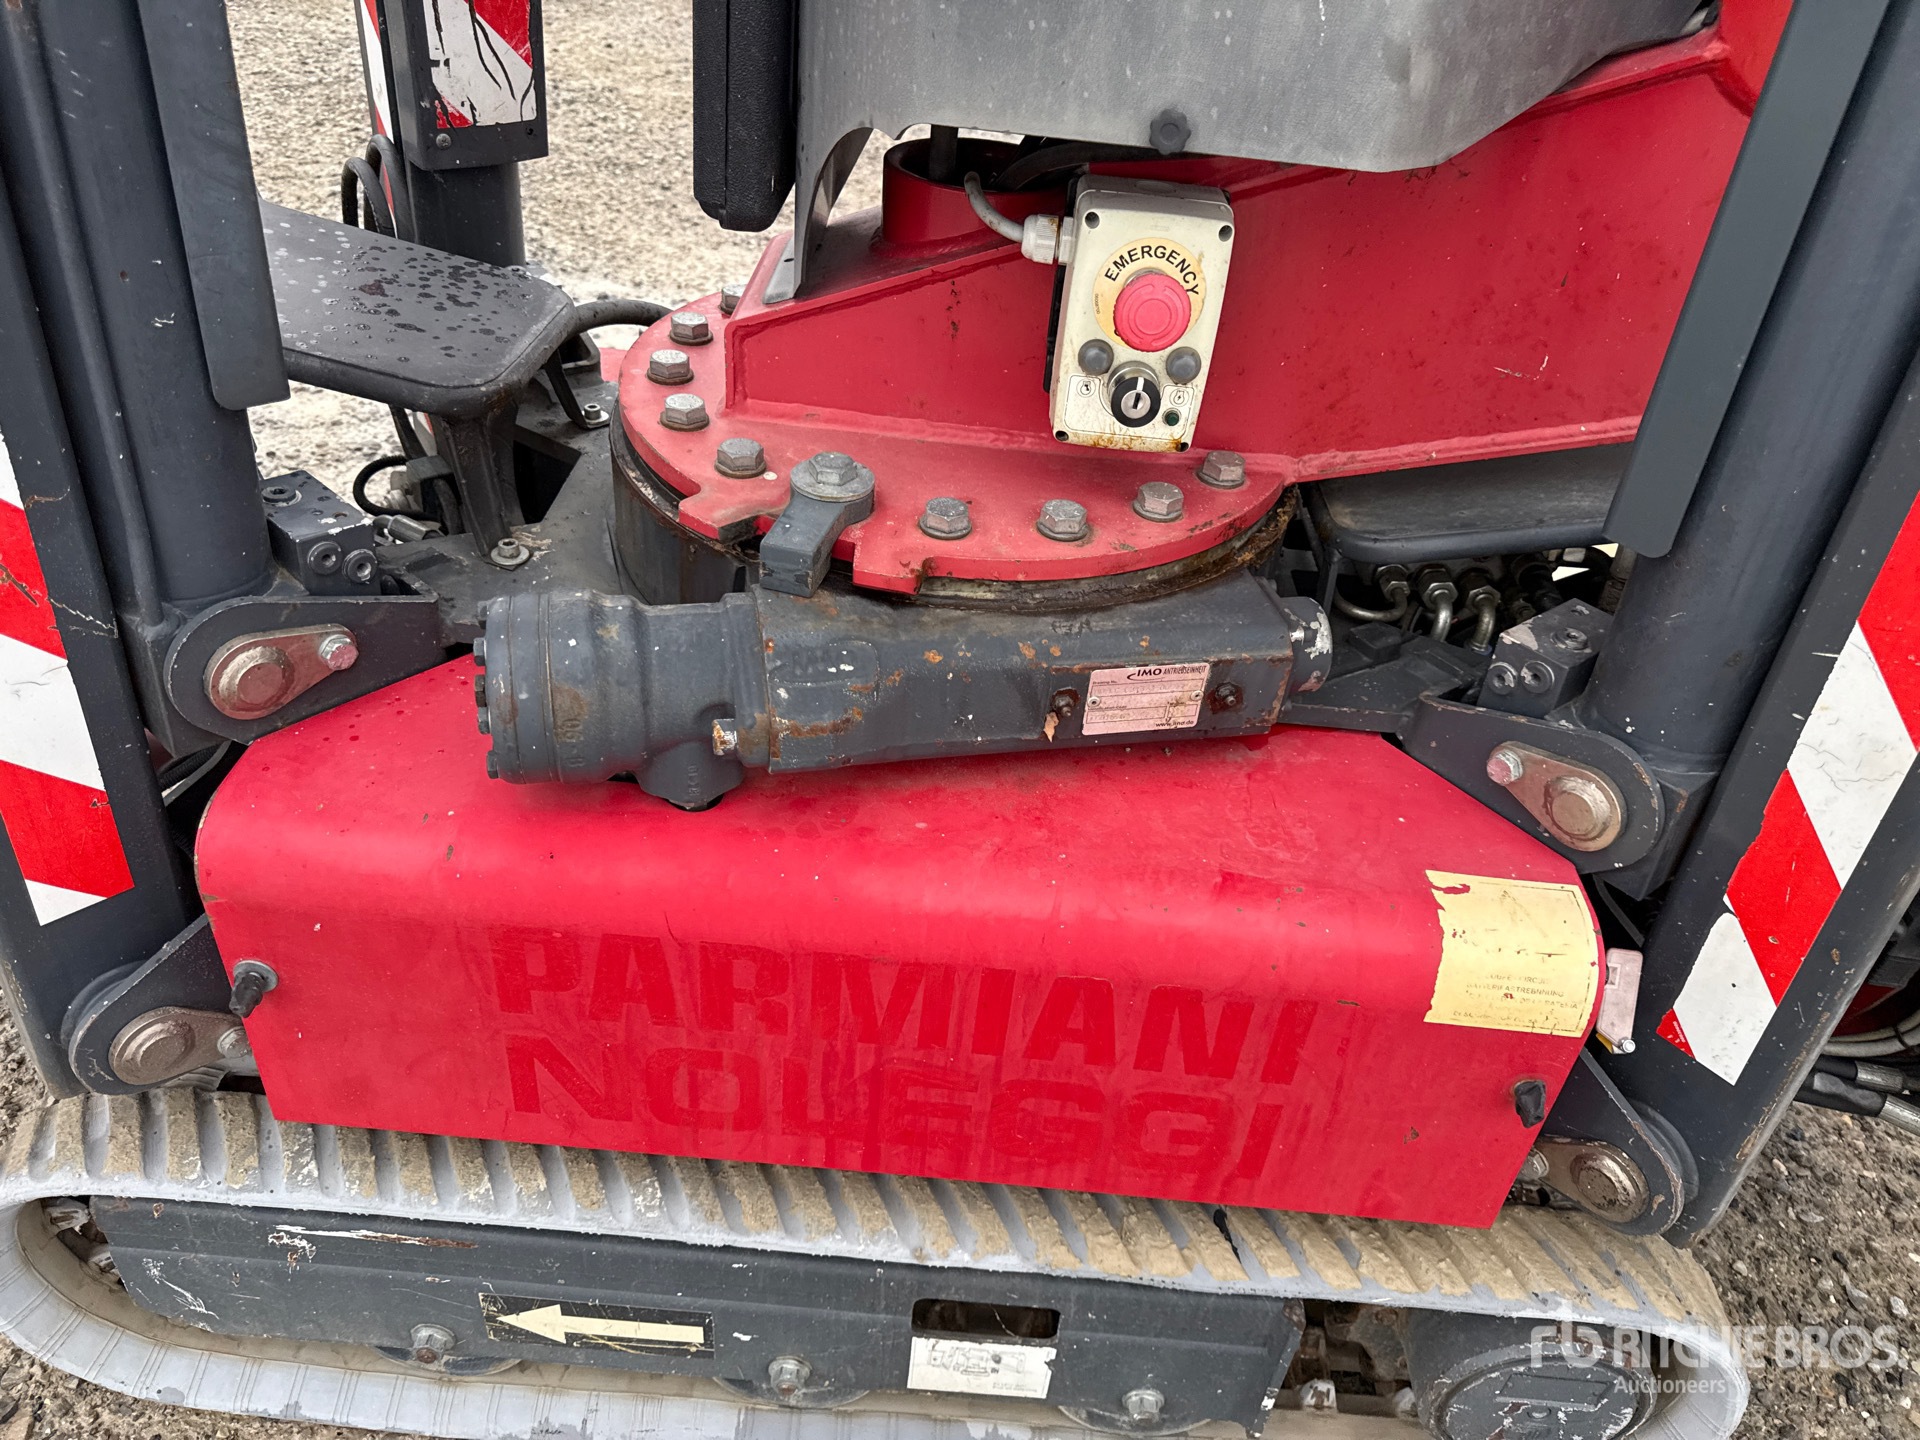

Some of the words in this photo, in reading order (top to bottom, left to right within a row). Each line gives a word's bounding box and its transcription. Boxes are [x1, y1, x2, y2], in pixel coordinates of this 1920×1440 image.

[1104, 245, 1199, 295] EMERGENCY
[1137, 668, 1162, 677] IMO
[491, 926, 1318, 1085] PARMIANI
[505, 1033, 1283, 1179] NOLEGGI
